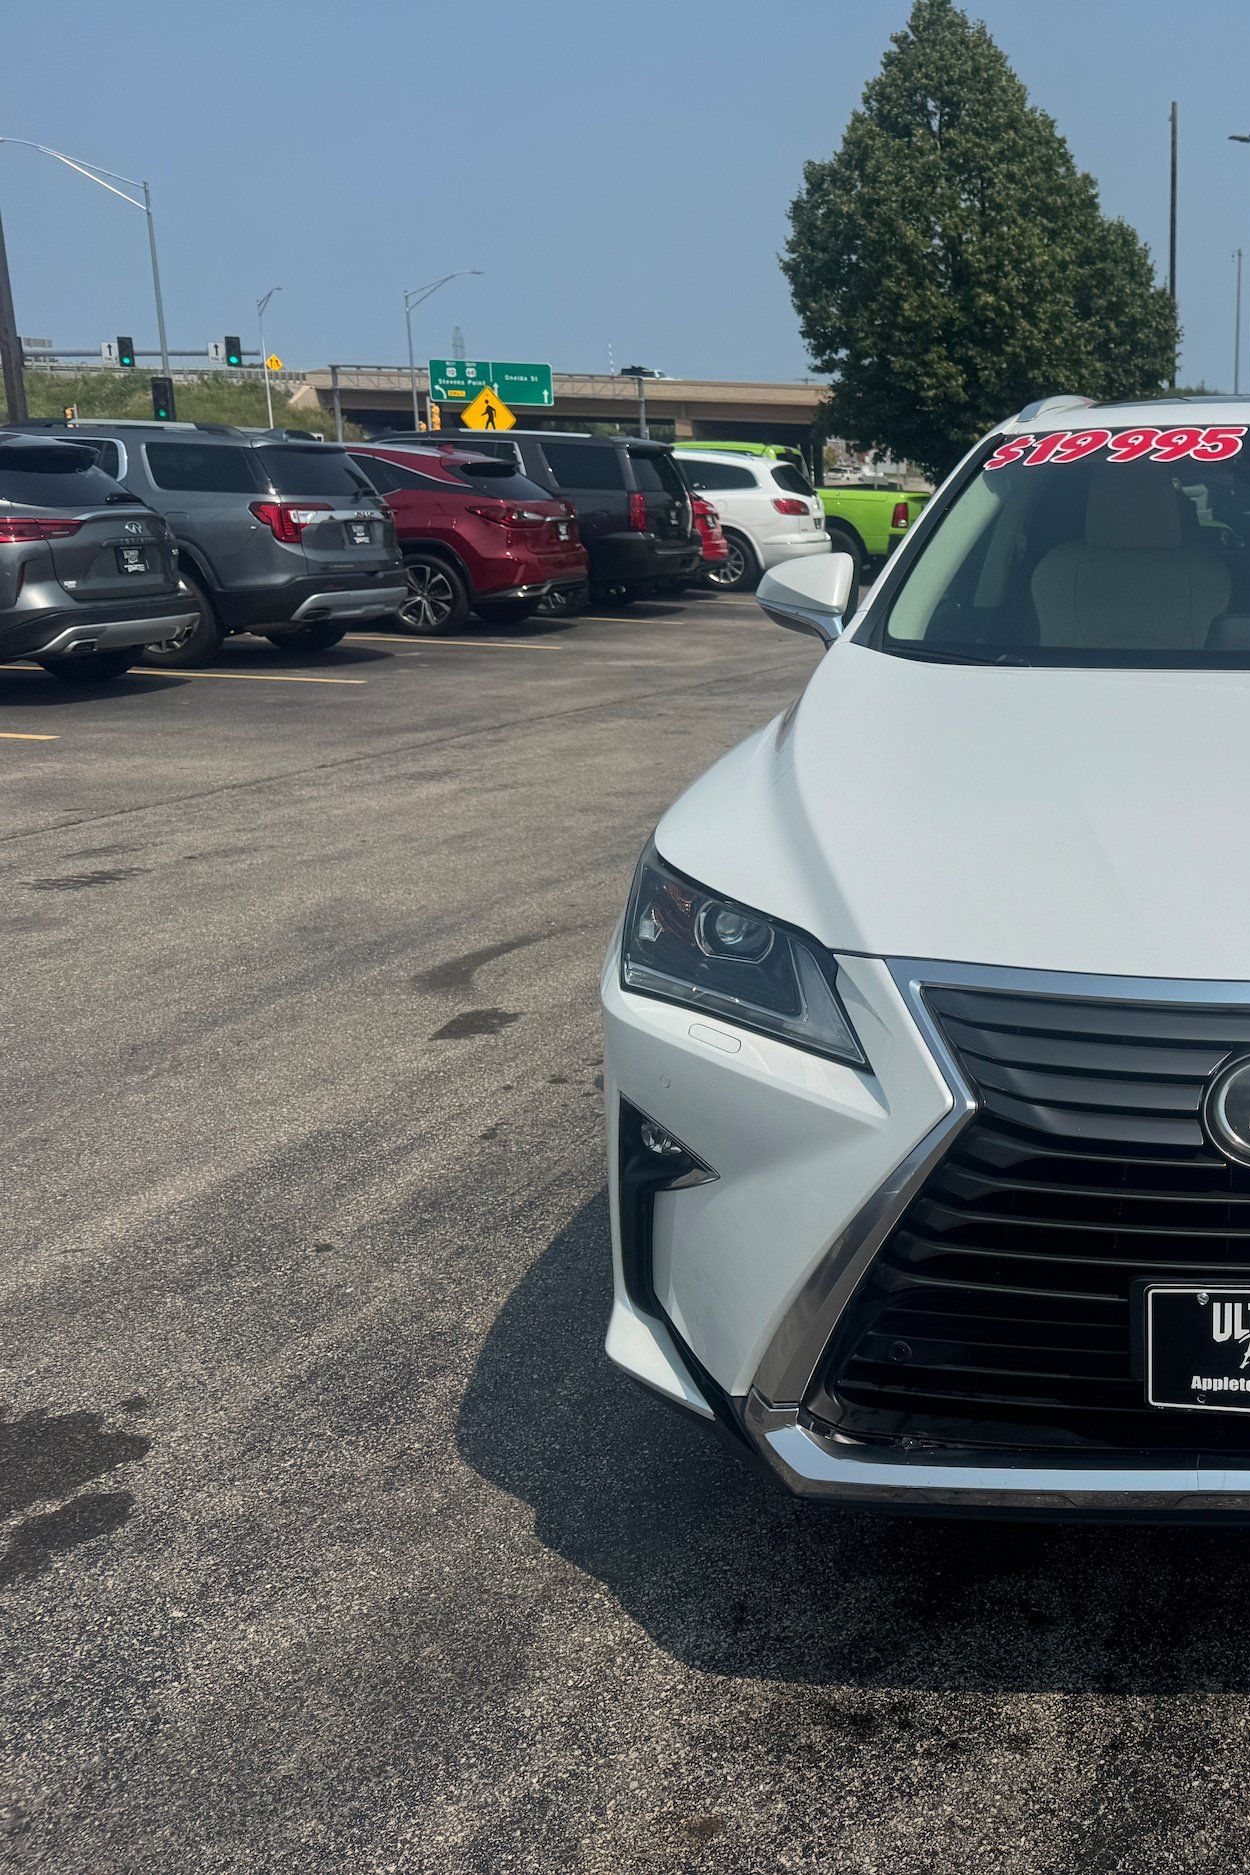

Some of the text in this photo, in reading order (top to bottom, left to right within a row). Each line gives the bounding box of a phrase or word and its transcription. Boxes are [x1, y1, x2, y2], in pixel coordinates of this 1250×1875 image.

[504, 374, 528, 382] Oneida
[438, 378, 486, 387] Stevens Point
